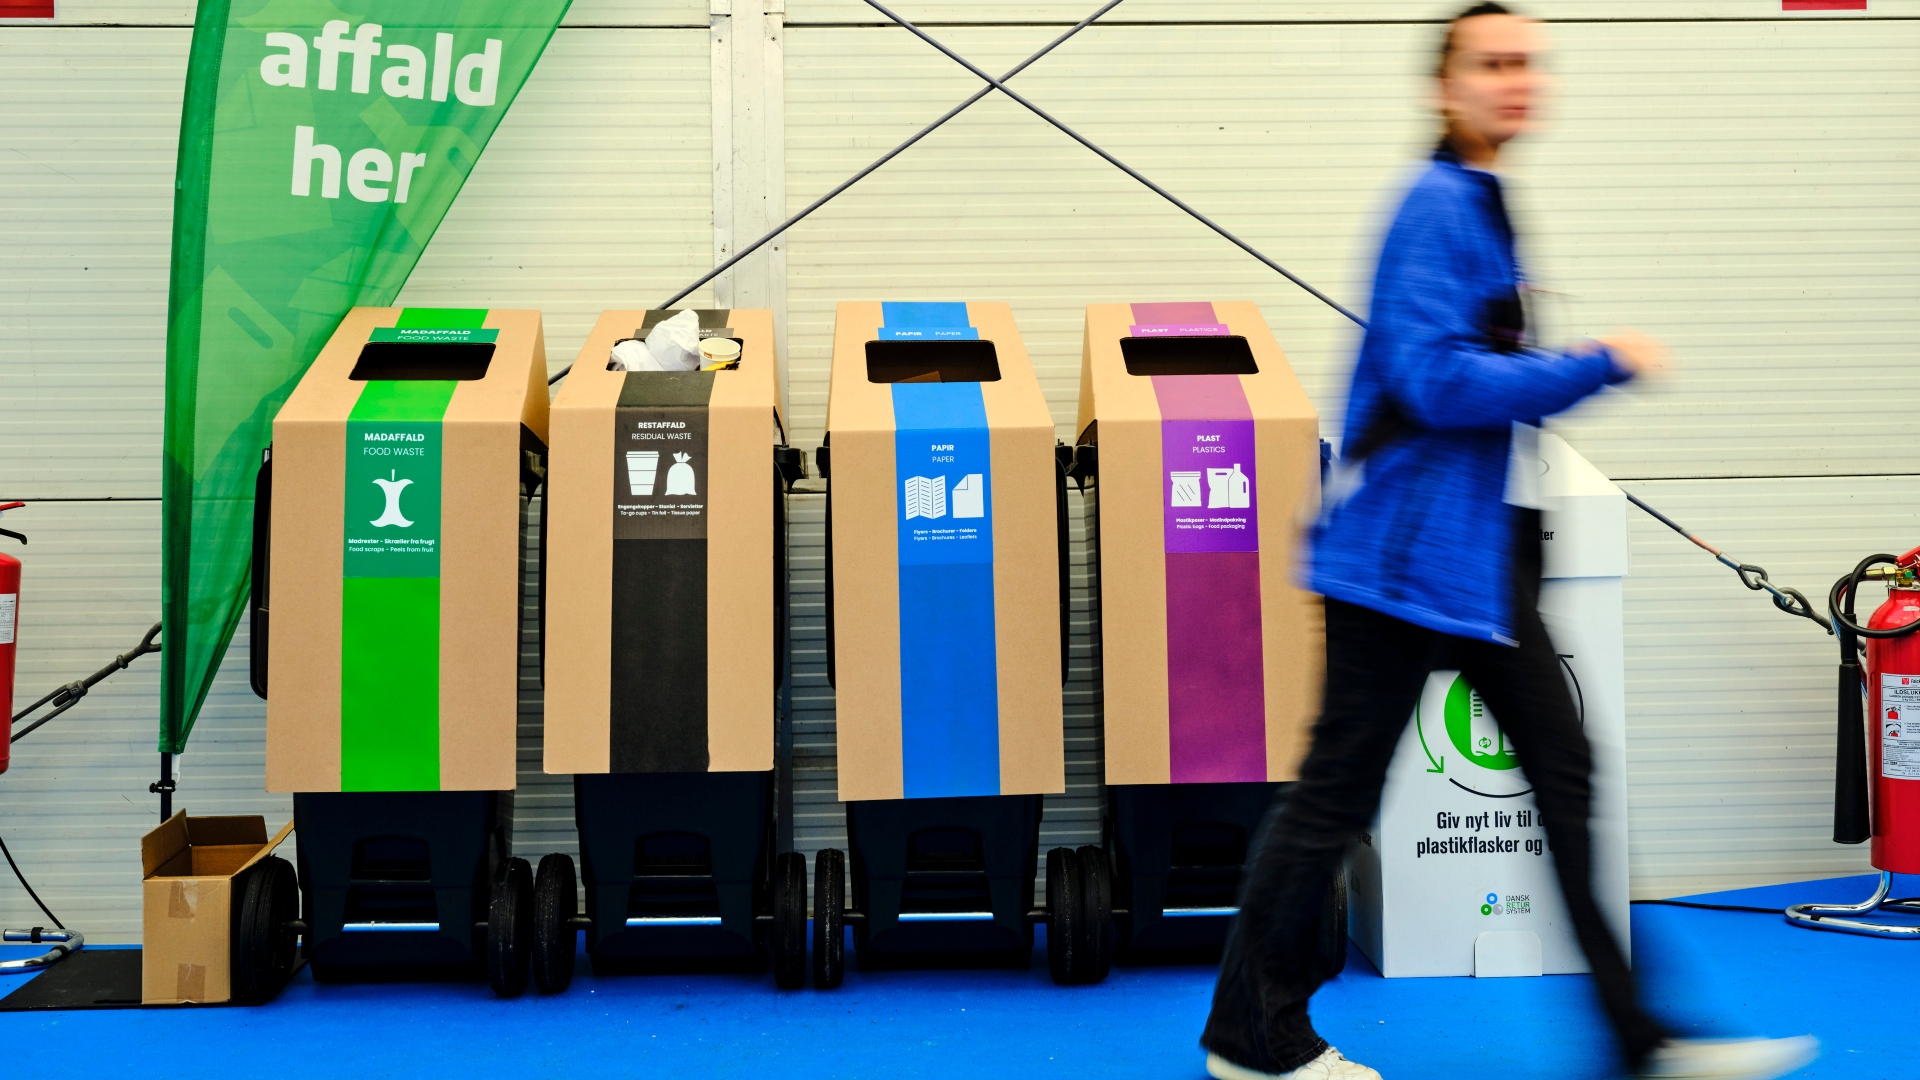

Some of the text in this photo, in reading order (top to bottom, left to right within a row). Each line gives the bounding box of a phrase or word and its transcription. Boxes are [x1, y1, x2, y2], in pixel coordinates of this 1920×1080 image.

[260, 20, 502, 106] affald
[291, 125, 426, 204] her
[364, 433, 425, 442] MADAFFALD
[363, 448, 425, 456] FOOD WASTE
[1437, 812, 1460, 829] Giv
[1465, 811, 1490, 832] nyt
[1494, 811, 1512, 828] liv
[1516, 810, 1532, 828] til
[1416, 836, 1520, 858] plastikflasker
[1525, 839, 1543, 856] og
